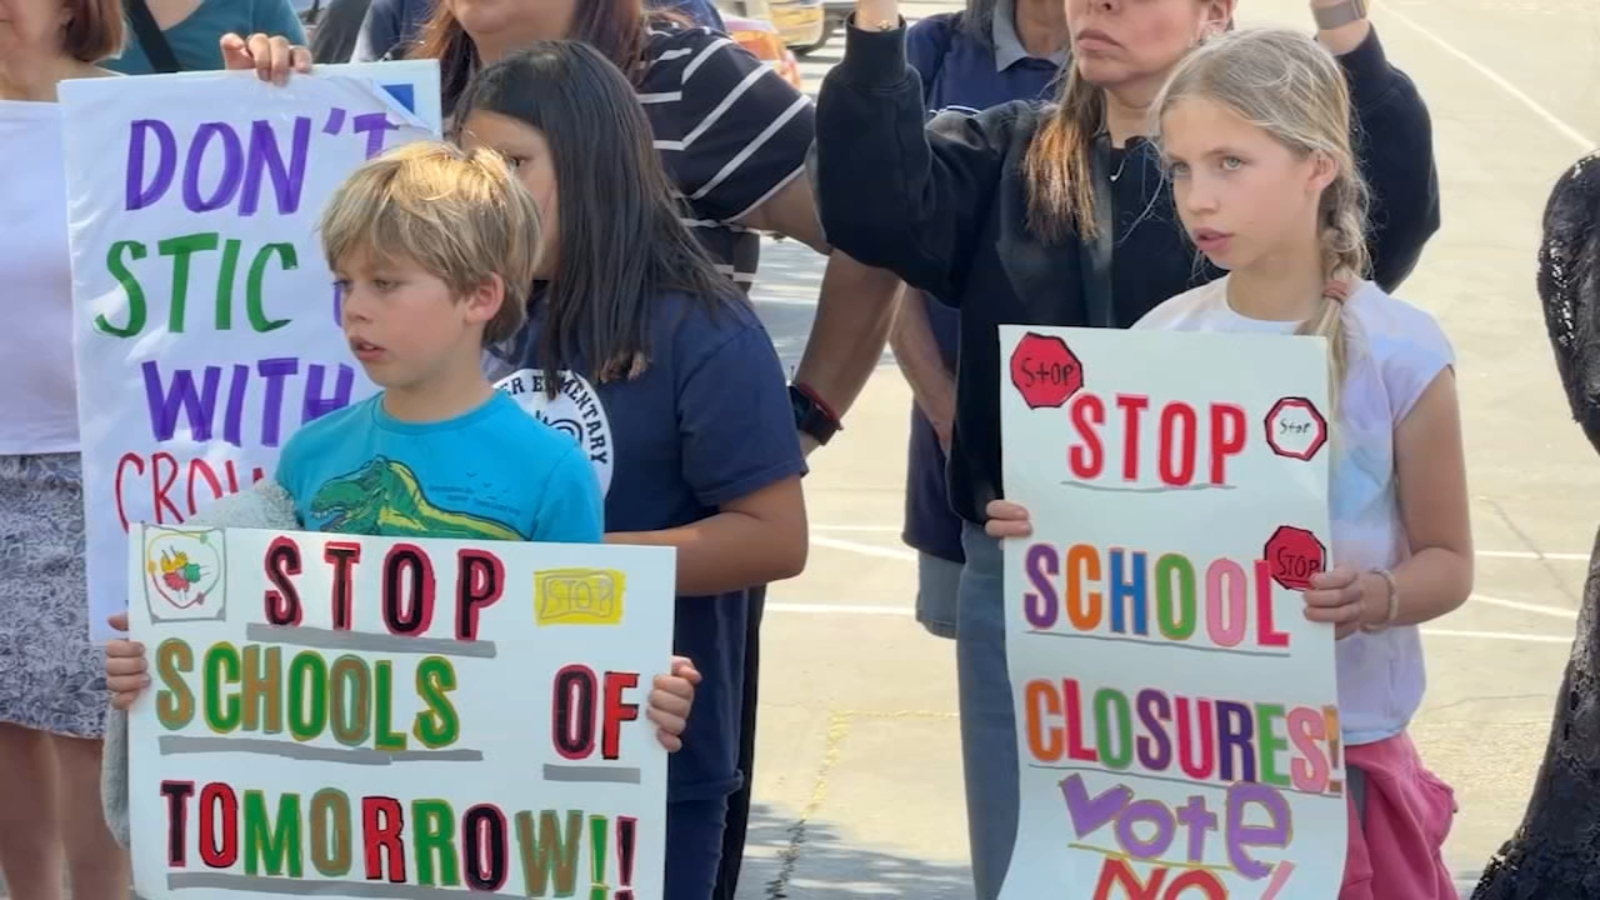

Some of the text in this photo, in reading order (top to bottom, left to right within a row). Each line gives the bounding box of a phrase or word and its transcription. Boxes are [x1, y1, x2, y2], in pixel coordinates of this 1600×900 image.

[124, 106, 399, 217] DON'T
[93, 231, 299, 338] STIC
[141, 357, 355, 448] WITH
[1067, 392, 1249, 488] STOP
[263, 535, 506, 642] STOP
[1023, 542, 1291, 648] SCHOOL
[1277, 546, 1321, 578] STOP
[155, 637, 641, 761] SCHOOLS OF
[1023, 677, 1343, 794] CLOSURES!
[160, 779, 639, 900] TOMORROW!!
